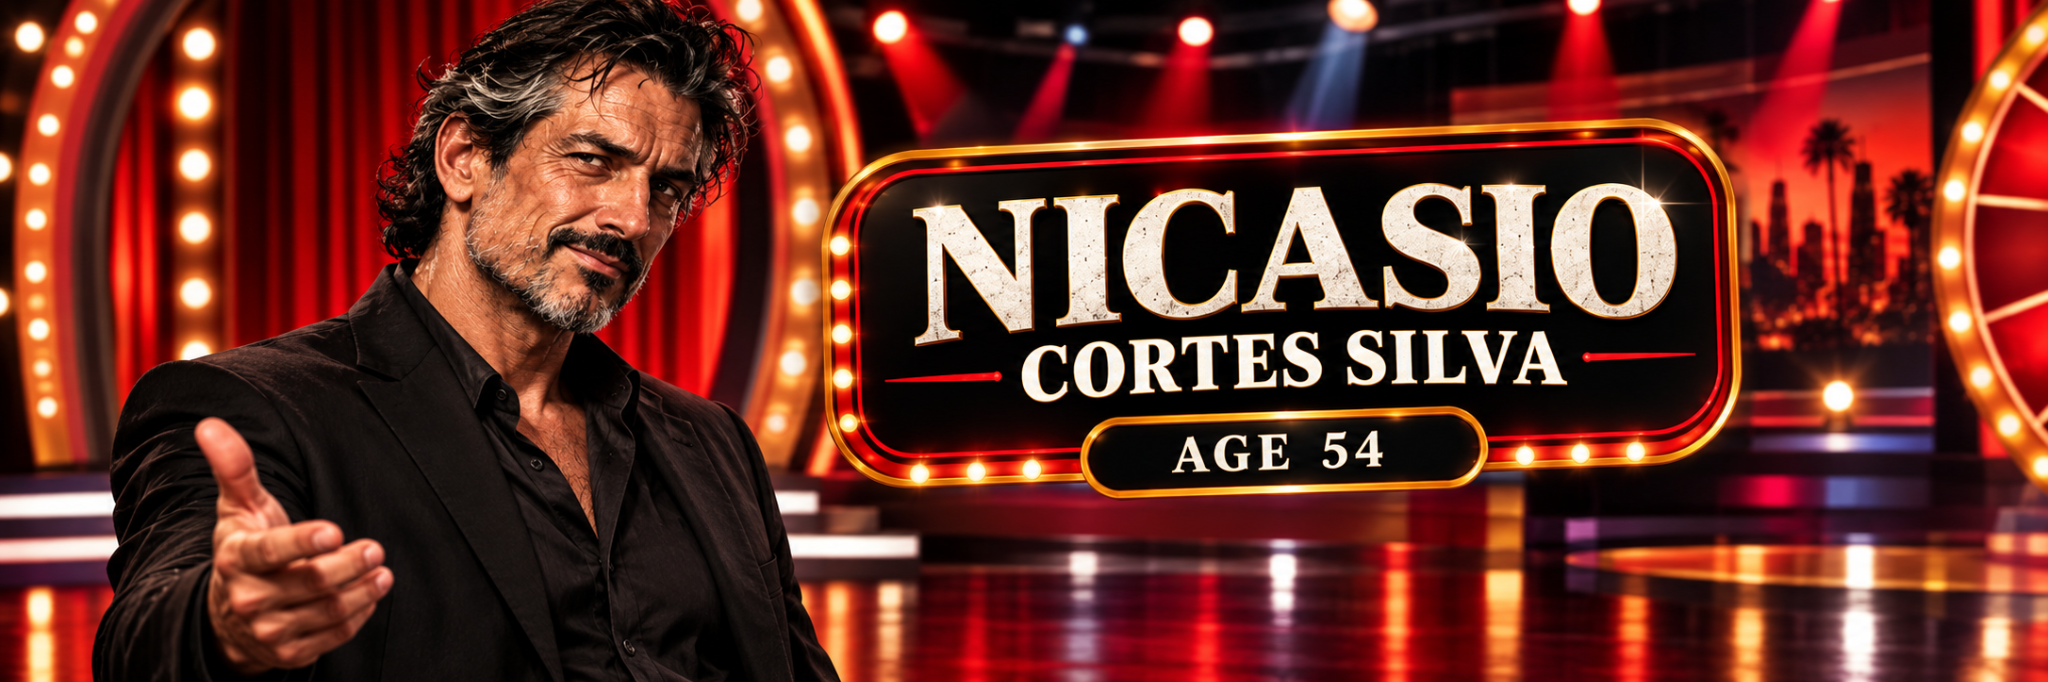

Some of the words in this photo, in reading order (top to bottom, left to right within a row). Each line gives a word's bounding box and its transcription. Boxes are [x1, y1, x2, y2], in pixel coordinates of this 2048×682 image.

[912, 182, 1678, 346] NICASIO
[1021, 330, 1323, 402] CORTES
[1346, 329, 1568, 387] SILVA
[1172, 433, 1291, 474] AGE
[1322, 430, 1384, 469] 54
